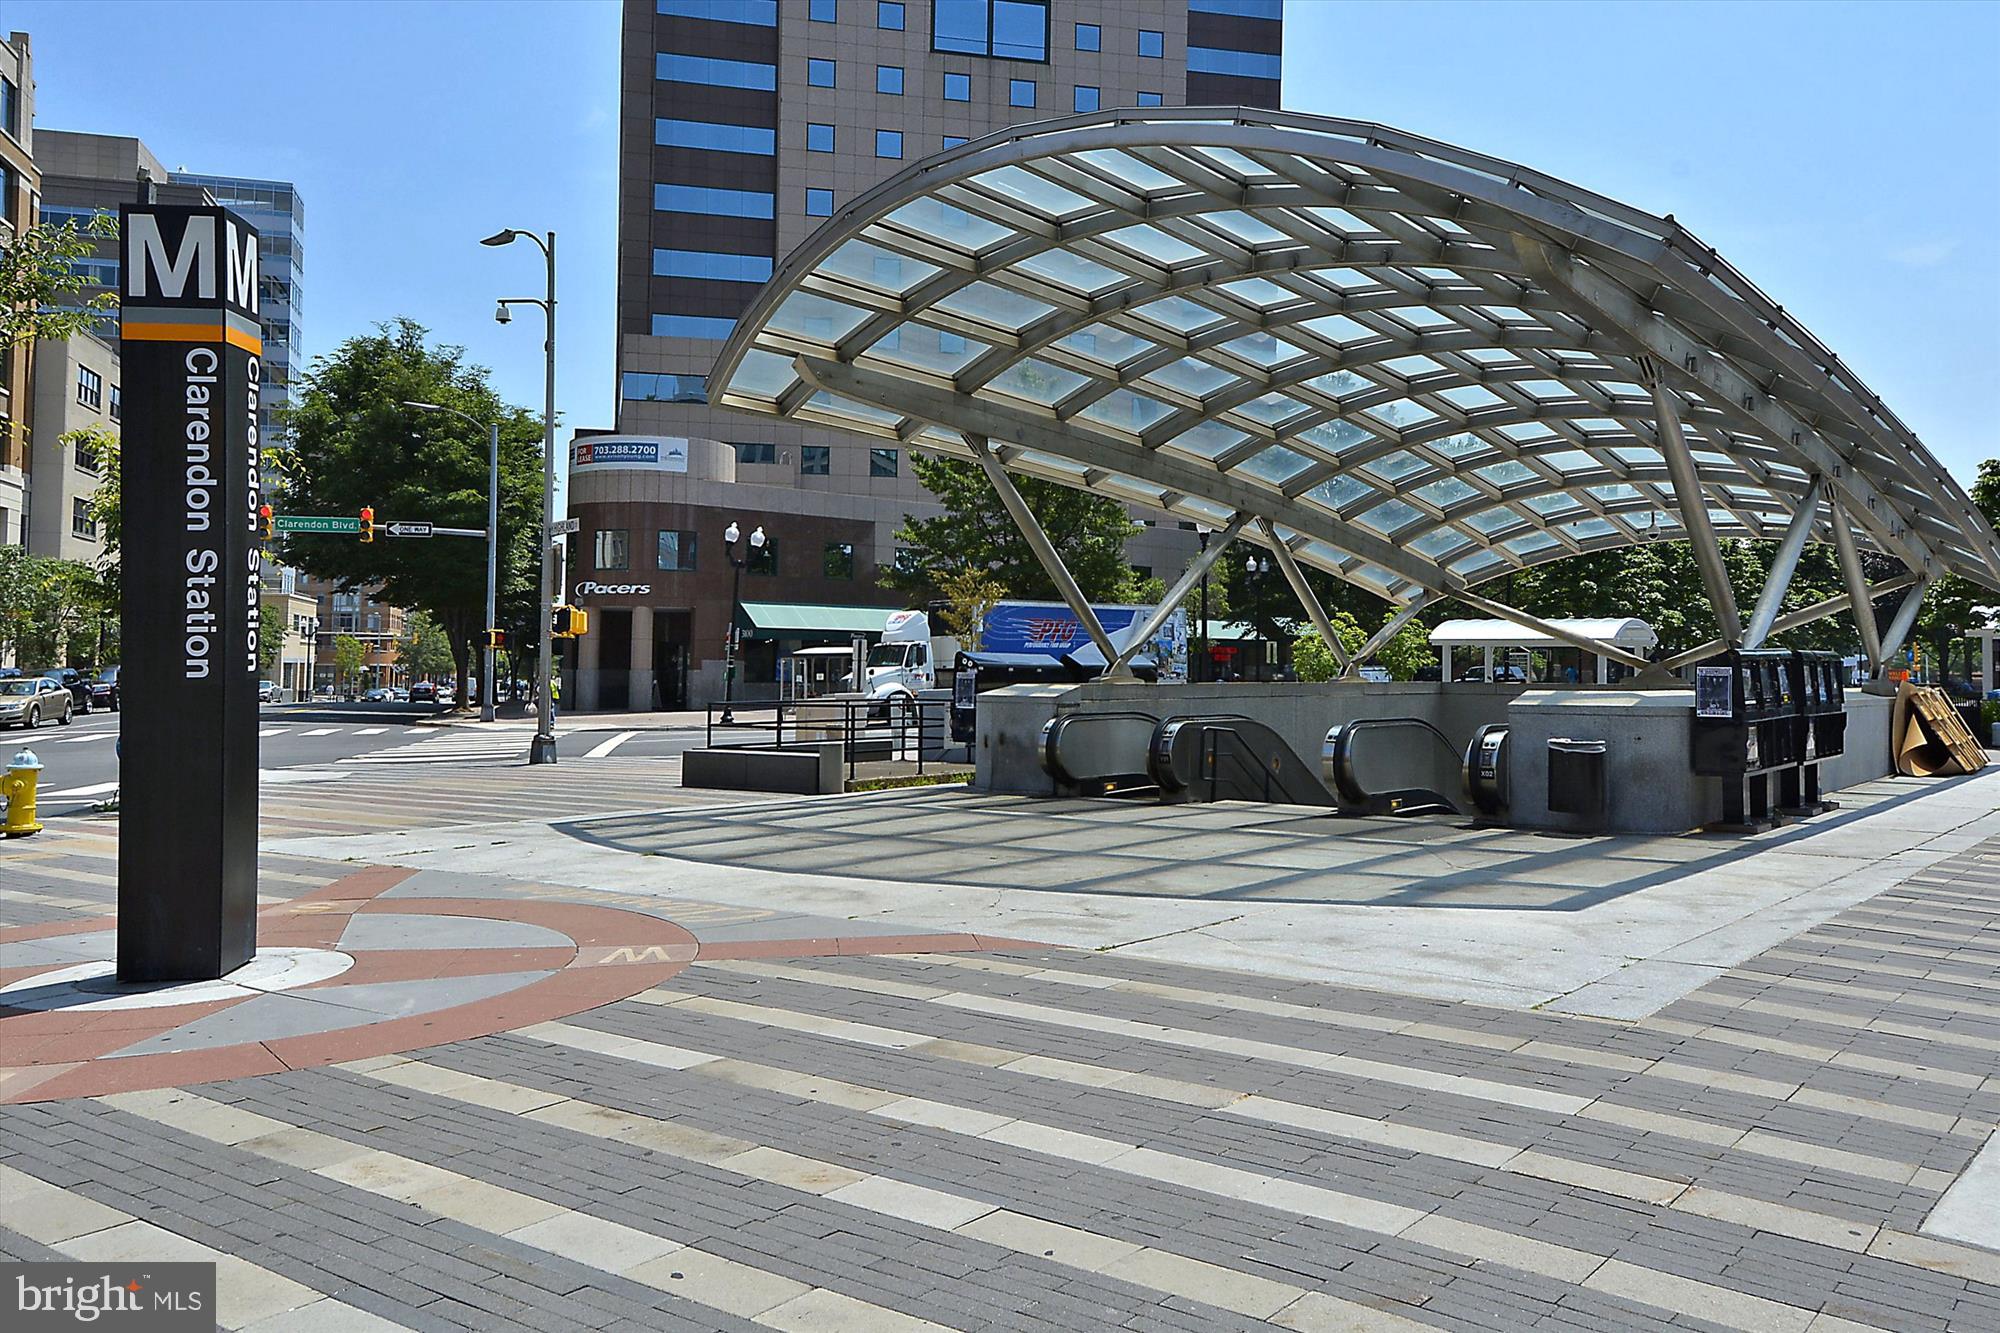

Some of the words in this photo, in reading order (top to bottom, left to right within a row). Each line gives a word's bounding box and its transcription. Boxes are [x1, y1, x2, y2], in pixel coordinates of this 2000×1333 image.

[128, 214, 216, 299] M
[226, 219, 259, 316] M
[185, 347, 218, 532] Clarendon
[246, 355, 261, 532] Clarendon
[578, 454, 592, 462] LEASE
[594, 445, 656, 455] 703.288.2700
[277, 519, 329, 529] Clarendon
[332, 520, 358, 530] Blvd.
[185, 548, 218, 679] Station
[246, 548, 261, 673] Station
[583, 581, 651, 594] Pacers
[1039, 618, 1077, 642] PFG
